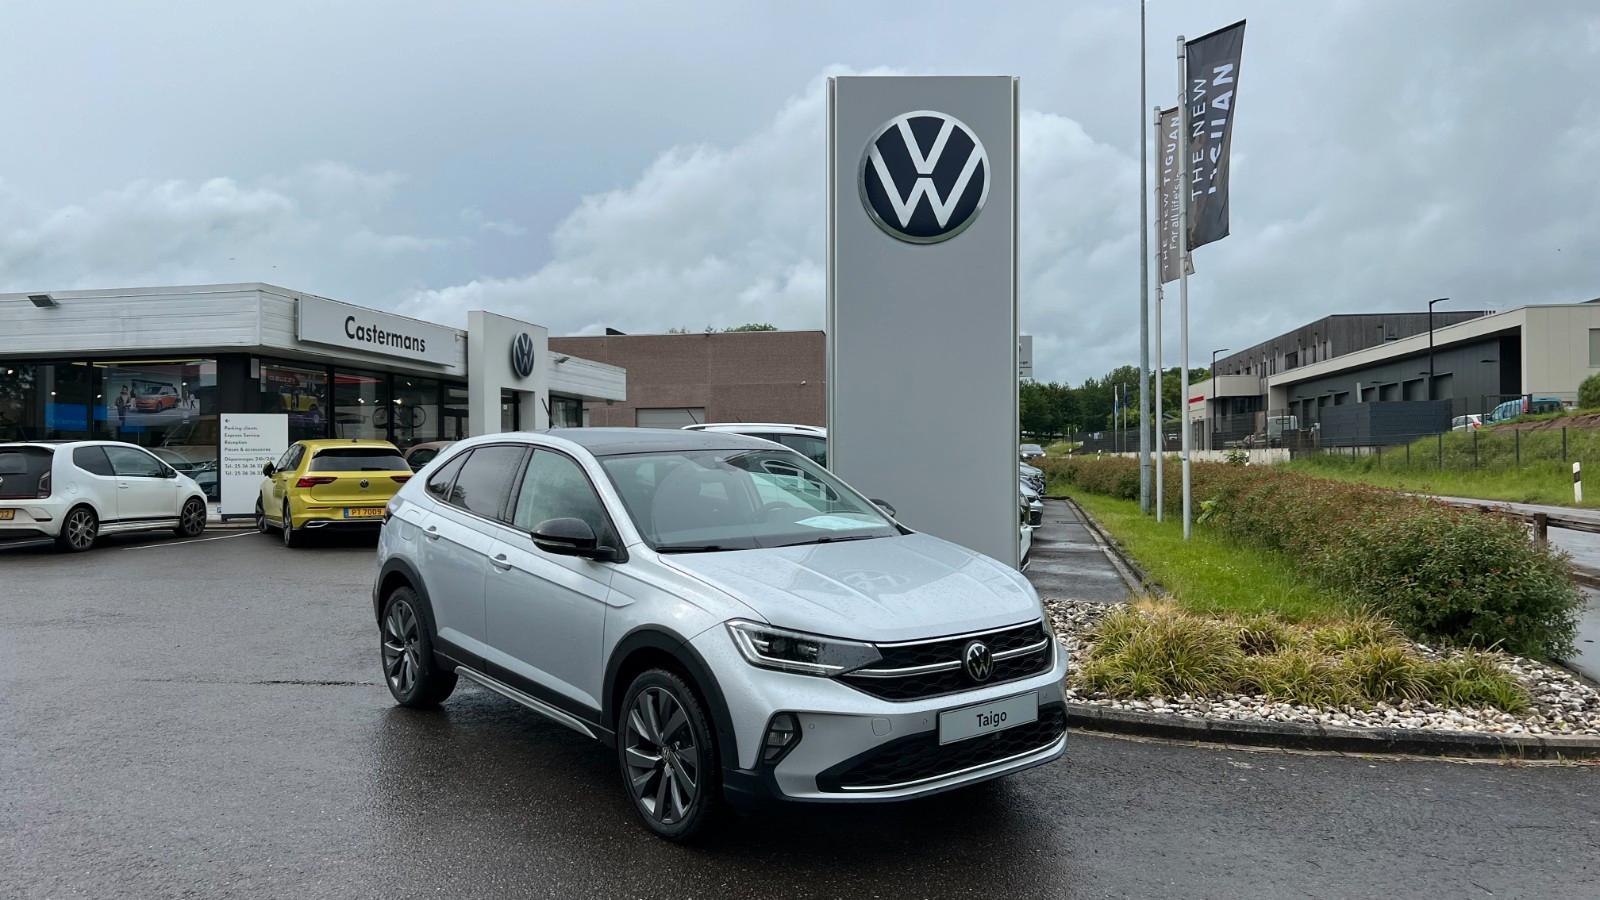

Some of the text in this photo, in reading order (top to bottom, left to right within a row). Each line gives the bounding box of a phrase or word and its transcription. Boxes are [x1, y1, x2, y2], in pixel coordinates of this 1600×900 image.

[1163, 116, 1180, 187] TIGUAN
[1191, 79, 1207, 202] THE NEW
[1170, 214, 1179, 228] all
[1169, 230, 1179, 250] For
[344, 316, 426, 353] Castermans
[976, 711, 1007, 728] Taigo
